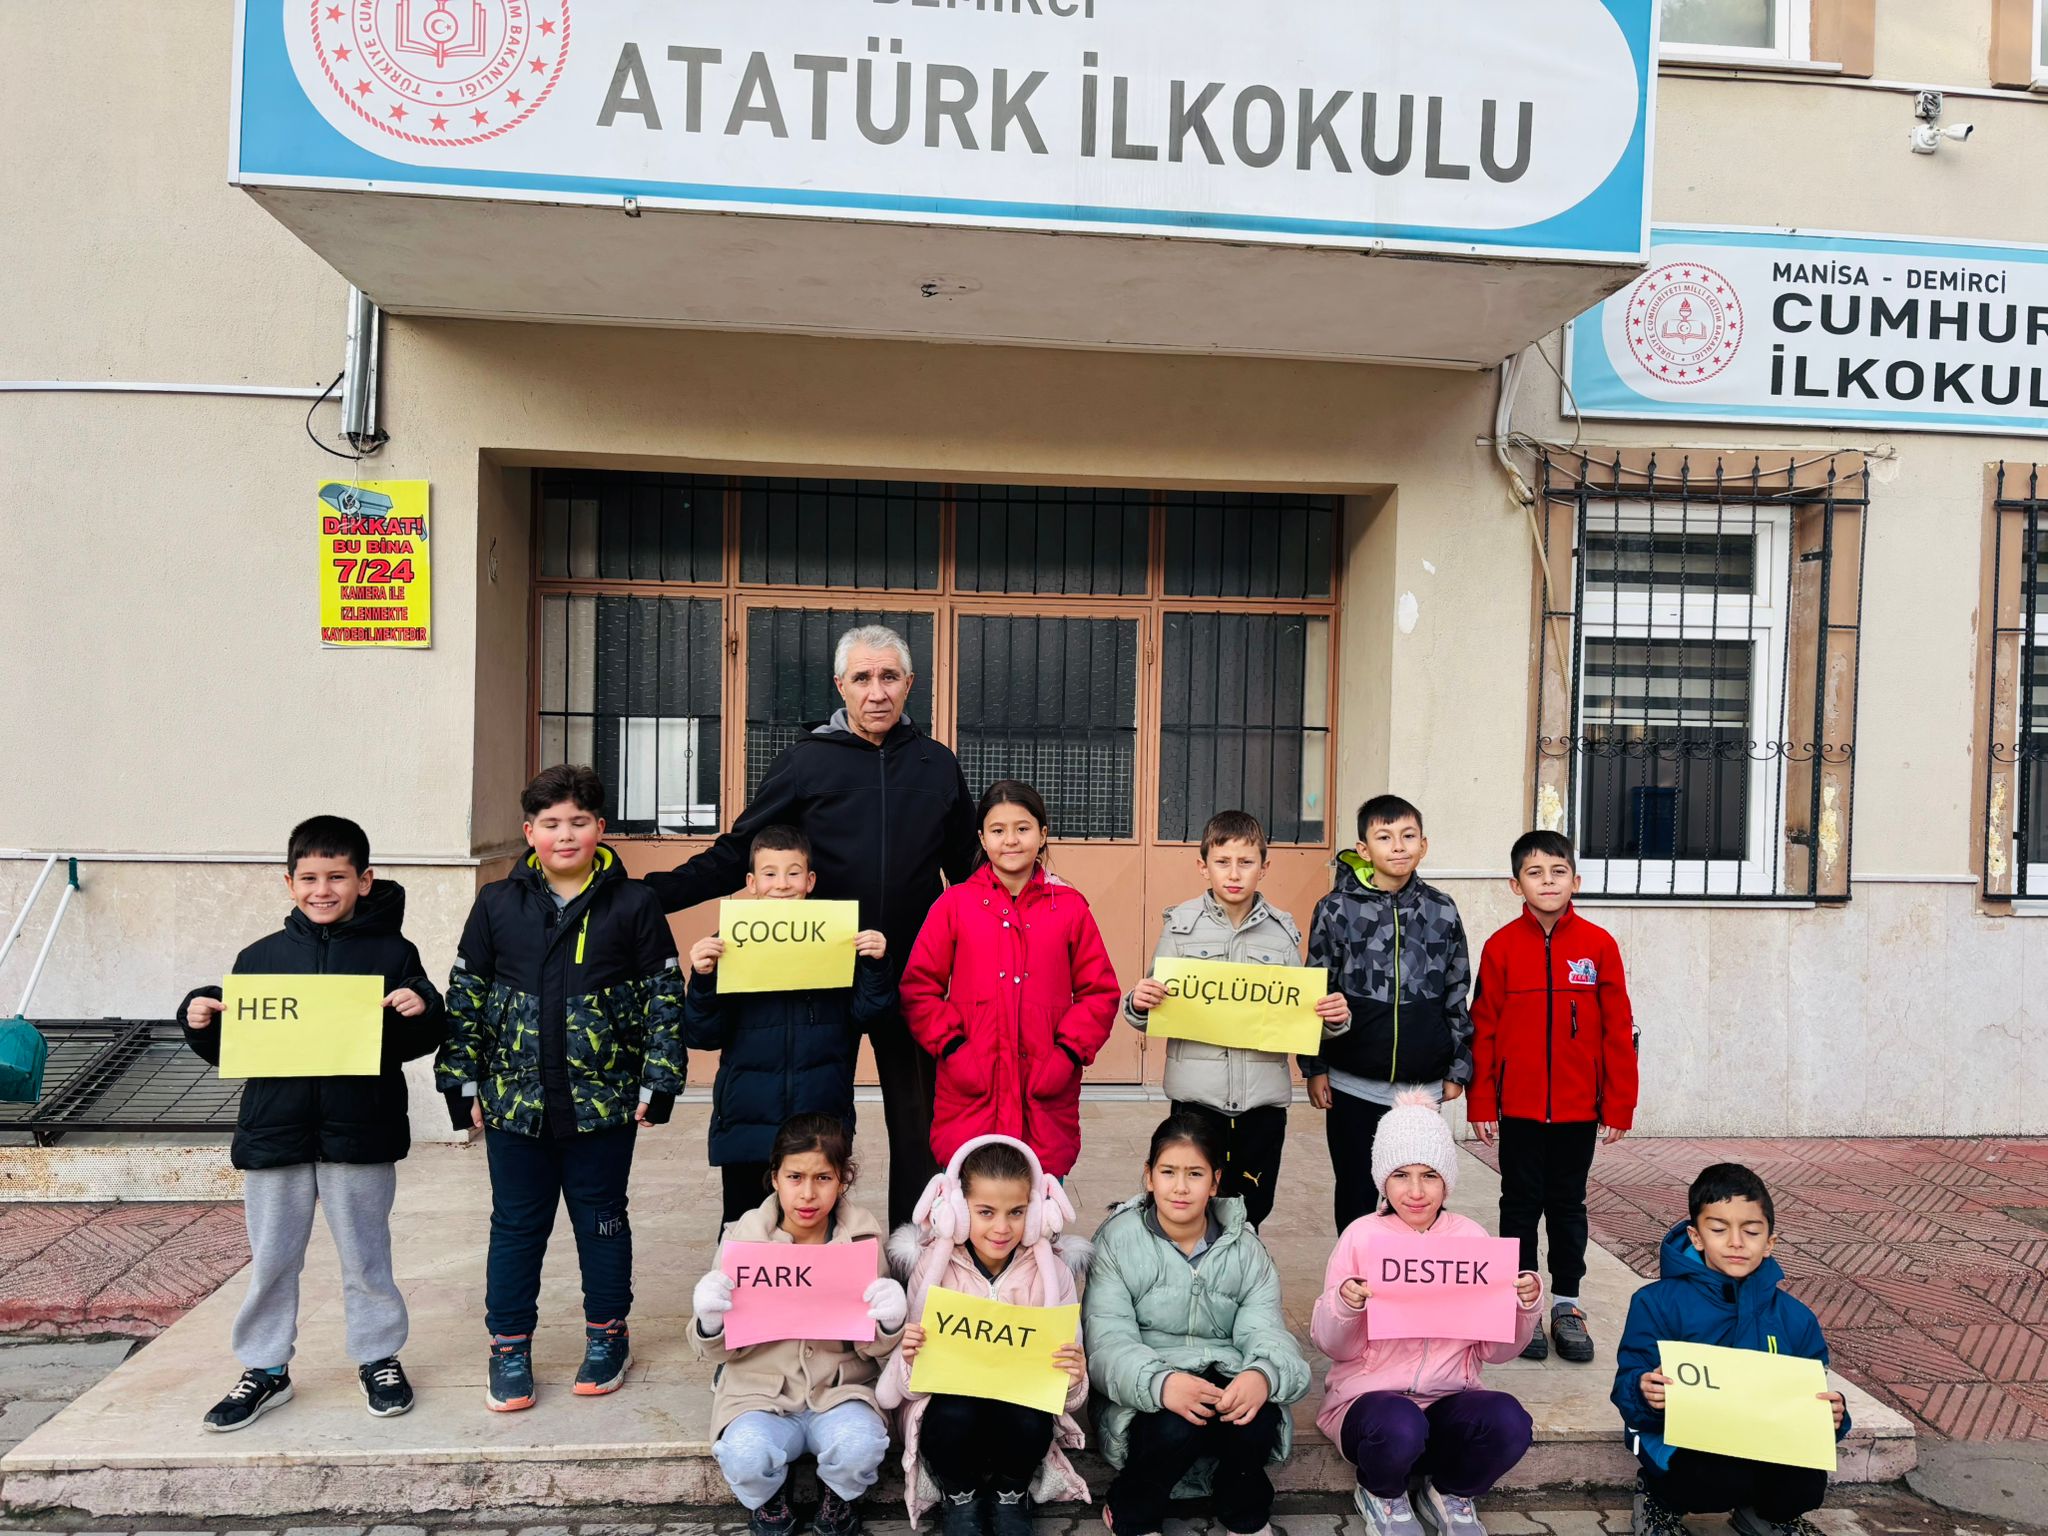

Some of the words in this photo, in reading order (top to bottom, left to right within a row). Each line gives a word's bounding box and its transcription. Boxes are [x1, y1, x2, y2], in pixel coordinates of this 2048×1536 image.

[364, 38, 421, 96] TÜRKİYE
[596, 36, 1049, 155] ATATÜRK
[1080, 51, 1533, 183] İLKOKULU
[1772, 260, 1869, 286] MANİSA
[1906, 267, 2006, 294] DEMİRCİ
[323, 513, 423, 536] DİKKAT!
[333, 539, 361, 553] BU
[366, 537, 414, 554] BİNA
[333, 559, 415, 583] 7/24
[340, 586, 387, 600] KAMERA
[731, 921, 826, 948] ÇOCUK
[1164, 974, 1300, 1006] GÜÇLÜDÜR
[237, 997, 299, 1020] HER
[736, 1266, 812, 1288] FARK
[1381, 1258, 1489, 1285] DESTEK
[936, 1311, 1037, 1348] YARAT
[1677, 1362, 1720, 1390] OL
